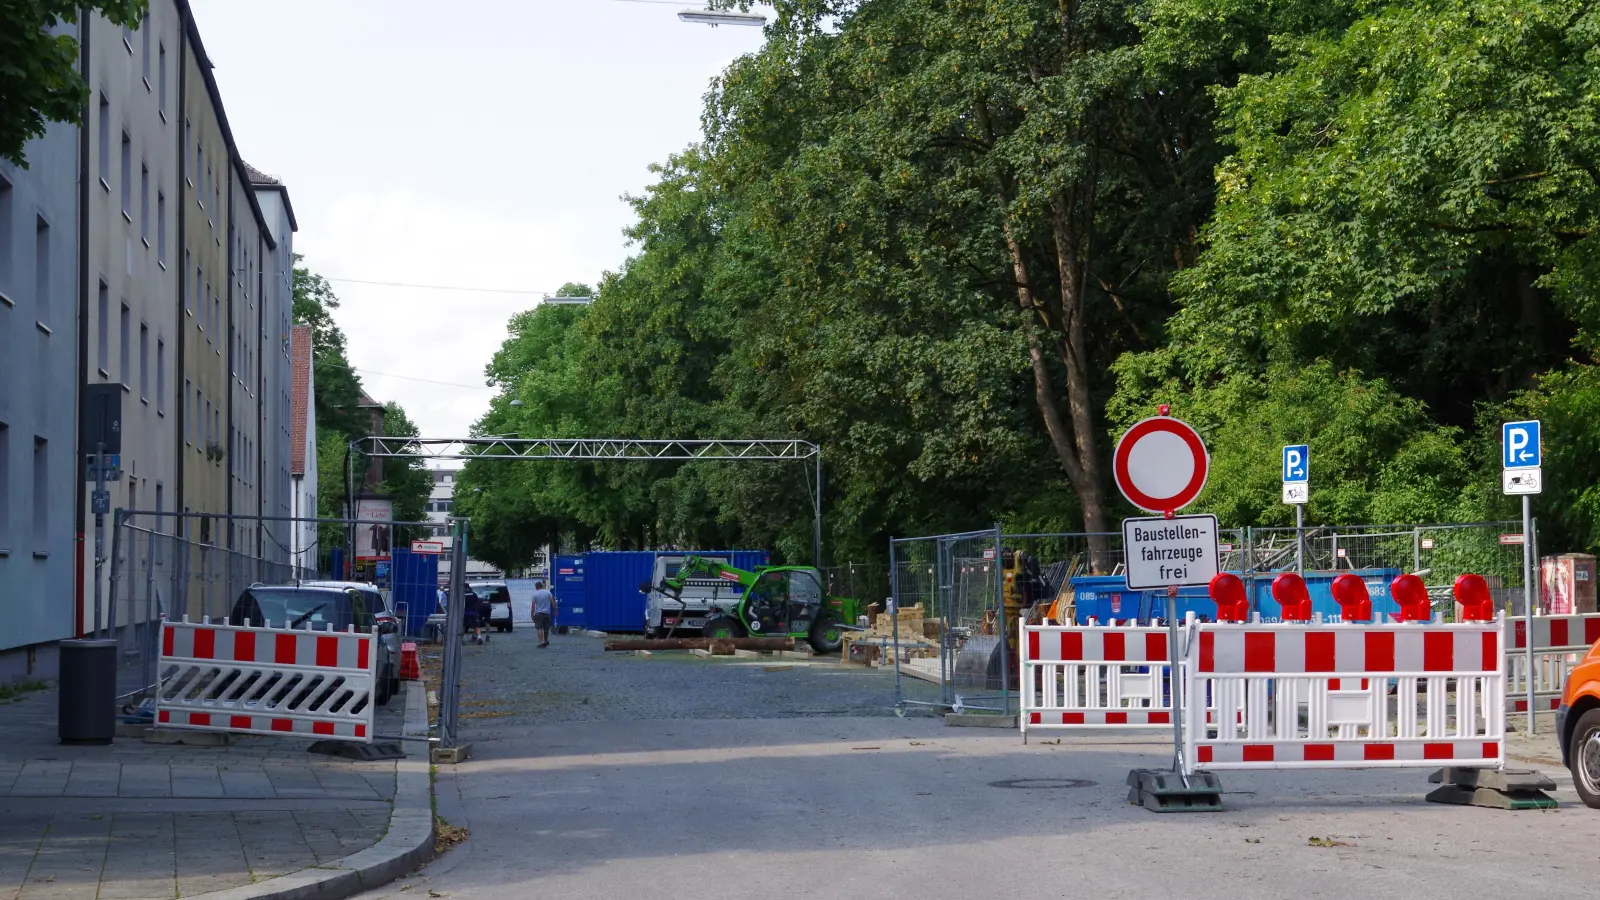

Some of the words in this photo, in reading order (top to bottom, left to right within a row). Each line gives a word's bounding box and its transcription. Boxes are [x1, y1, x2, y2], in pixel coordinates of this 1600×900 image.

[1509, 428, 1529, 463] P
[1287, 450, 1301, 478] P
[1134, 525, 1207, 542] Baustellen-
[1141, 546, 1203, 562] fahrzeuge
[1159, 564, 1188, 580] frei
